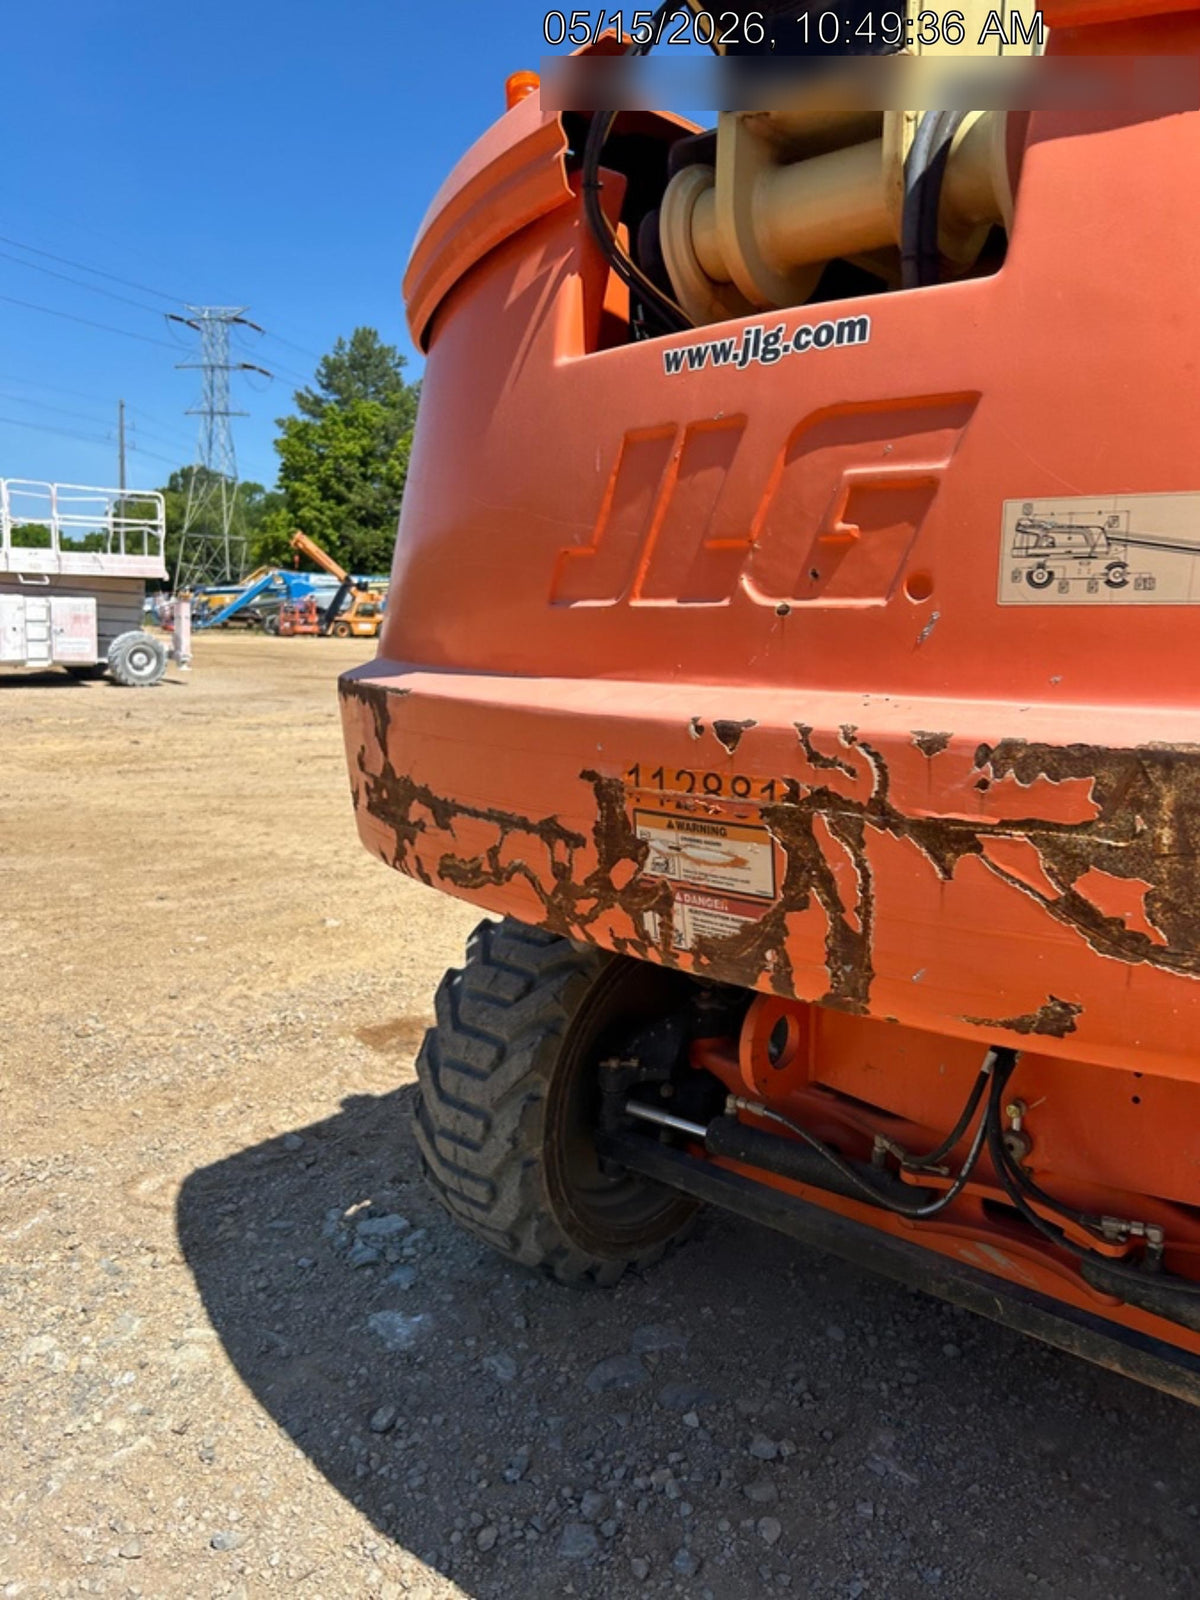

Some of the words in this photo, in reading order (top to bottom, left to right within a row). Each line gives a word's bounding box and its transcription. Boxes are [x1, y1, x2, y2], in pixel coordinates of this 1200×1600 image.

[663, 314, 870, 376] www.jlg.com
[549, 390, 983, 608] JLG
[676, 820, 728, 838] WARNING
